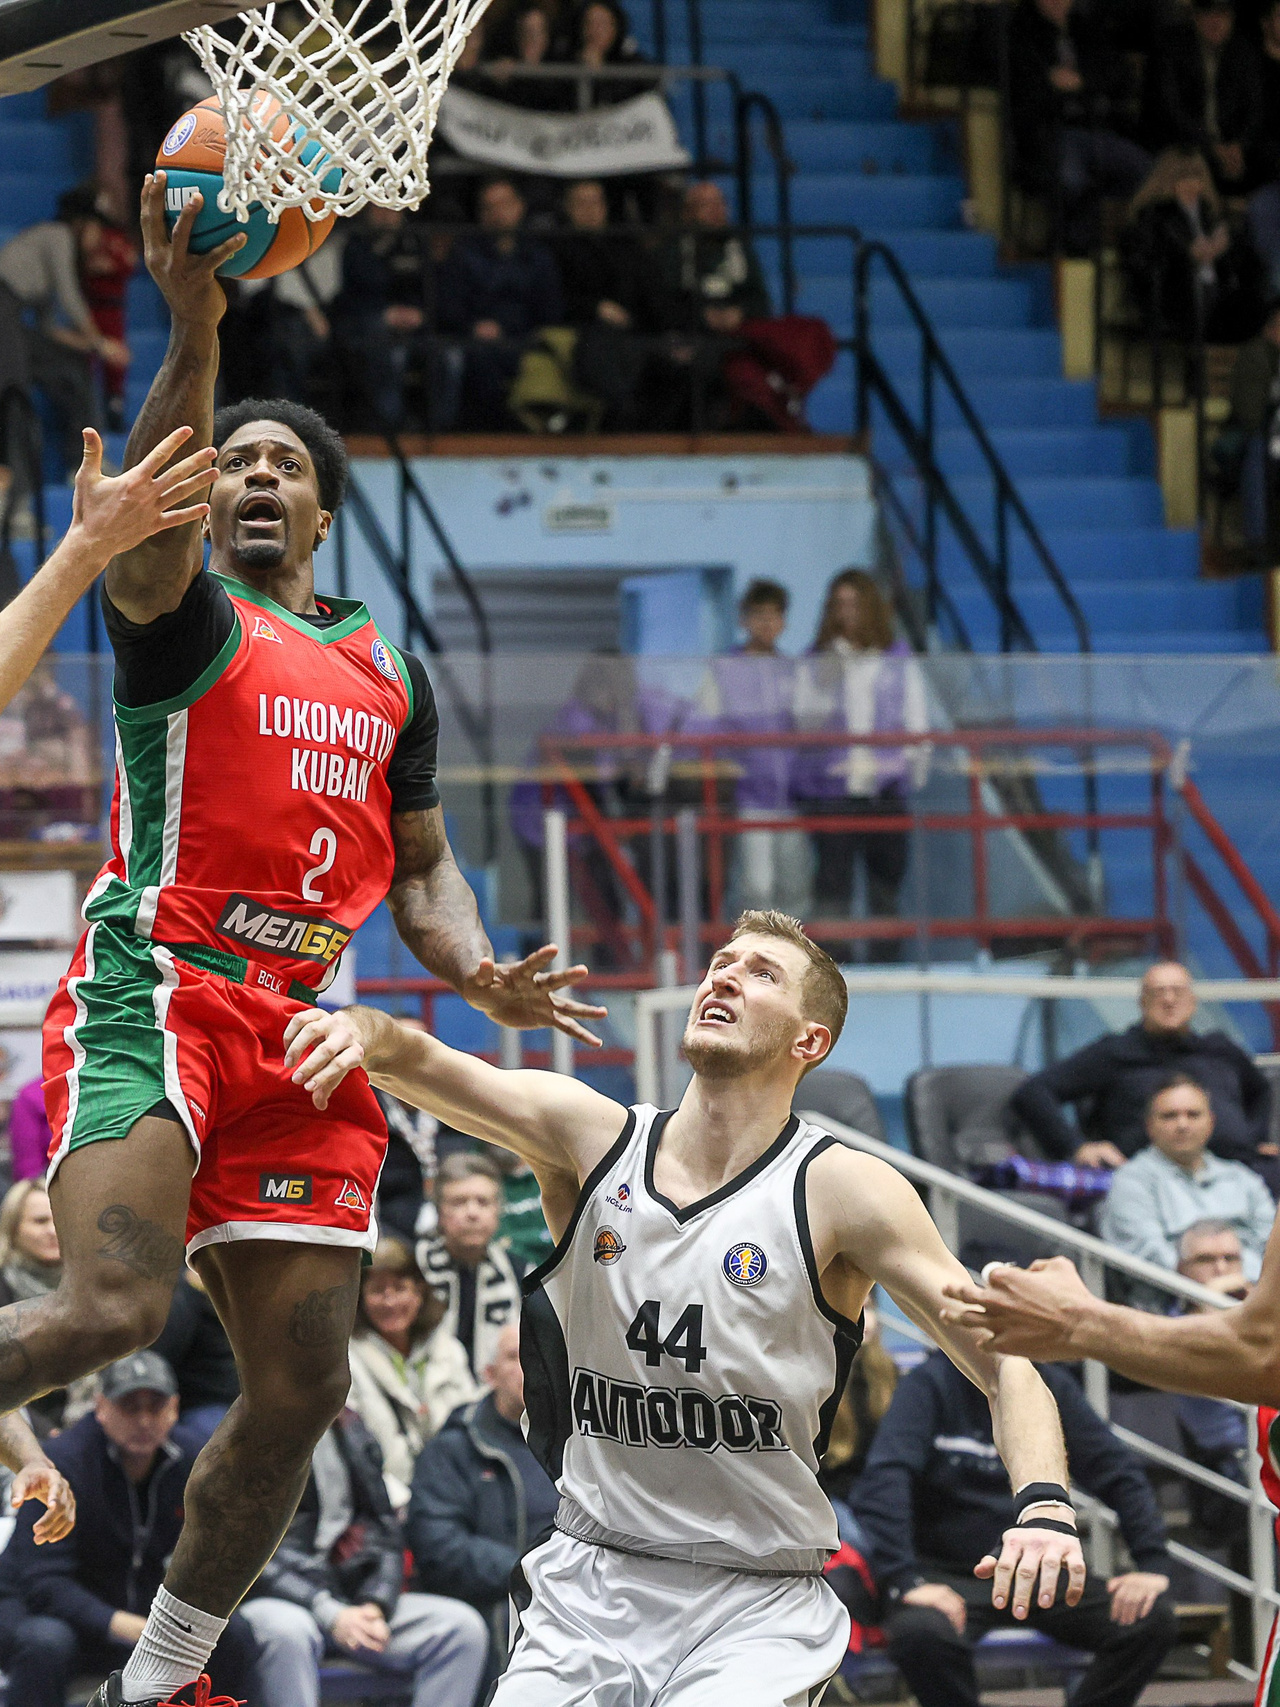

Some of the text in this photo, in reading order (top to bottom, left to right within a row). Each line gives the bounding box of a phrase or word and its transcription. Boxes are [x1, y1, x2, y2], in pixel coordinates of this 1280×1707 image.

[258, 693, 396, 764] LOKOMOTIV
[291, 747, 376, 803] KUBAN
[301, 827, 337, 903] 2
[257, 969, 284, 994] BCLK
[625, 1300, 707, 1373] 44
[571, 1367, 791, 1454] AVTODOR
